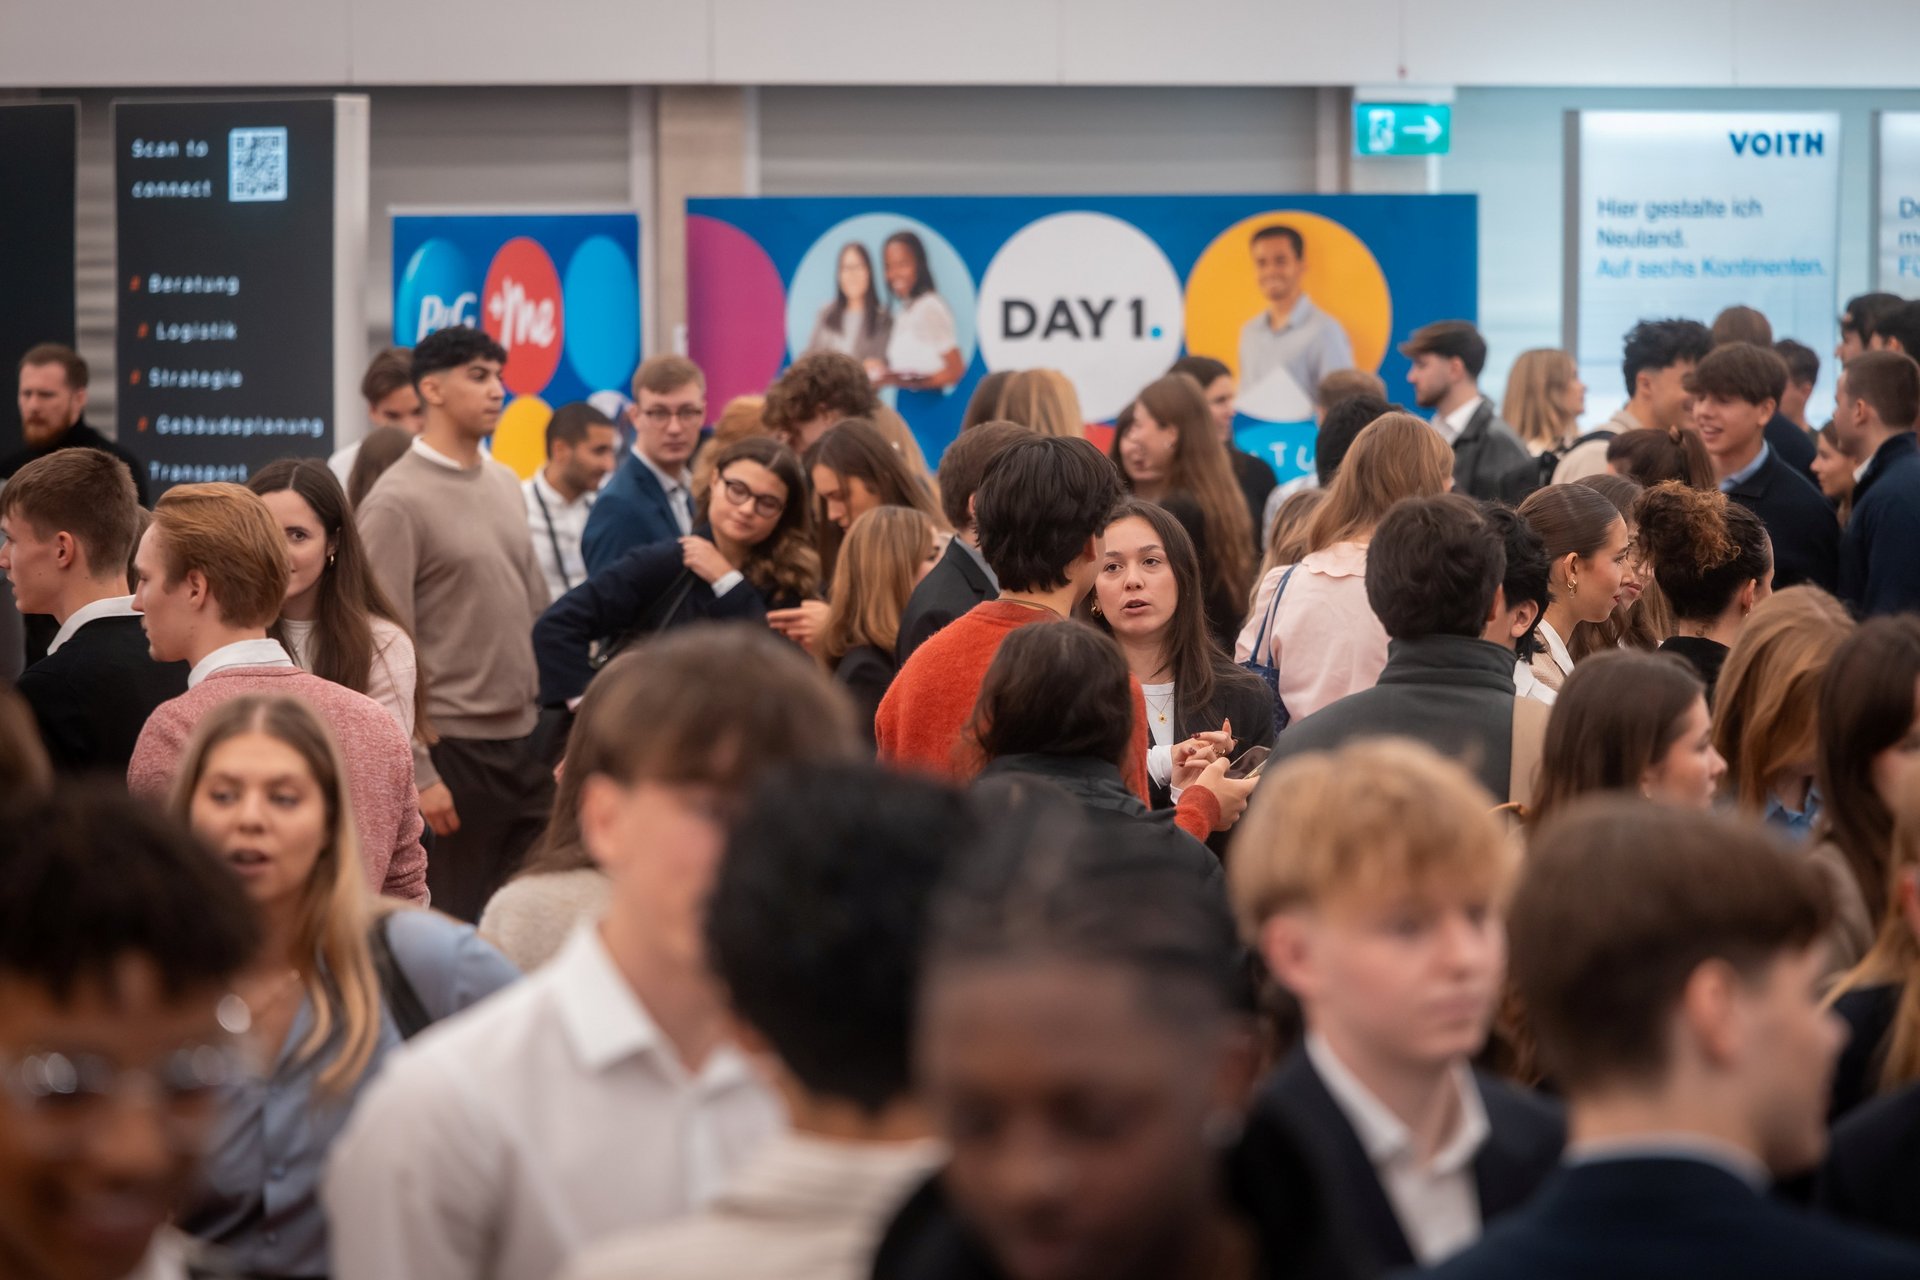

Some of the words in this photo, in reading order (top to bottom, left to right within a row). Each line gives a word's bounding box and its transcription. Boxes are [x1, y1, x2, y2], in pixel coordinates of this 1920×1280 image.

[131, 138, 179, 158] Scan
[186, 139, 209, 158] to
[1729, 131, 1825, 157] VOITH
[131, 180, 212, 198] connect
[1597, 199, 1637, 217] Hier
[1645, 198, 1726, 221] gestalte
[1732, 197, 1763, 217] ich
[1597, 228, 1686, 248] Neuland.
[1597, 257, 1632, 277] Auf
[1638, 256, 1696, 277] sechs
[1702, 255, 1826, 277] Kontinenten.
[148, 273, 240, 296] Beratung
[1001, 299, 1114, 340] DAY
[1129, 299, 1164, 340] 1.
[156, 320, 238, 343] Logistik
[148, 367, 243, 390] Strategie
[156, 413, 325, 438] Gebäudeplanung
[149, 460, 248, 482] Transport
